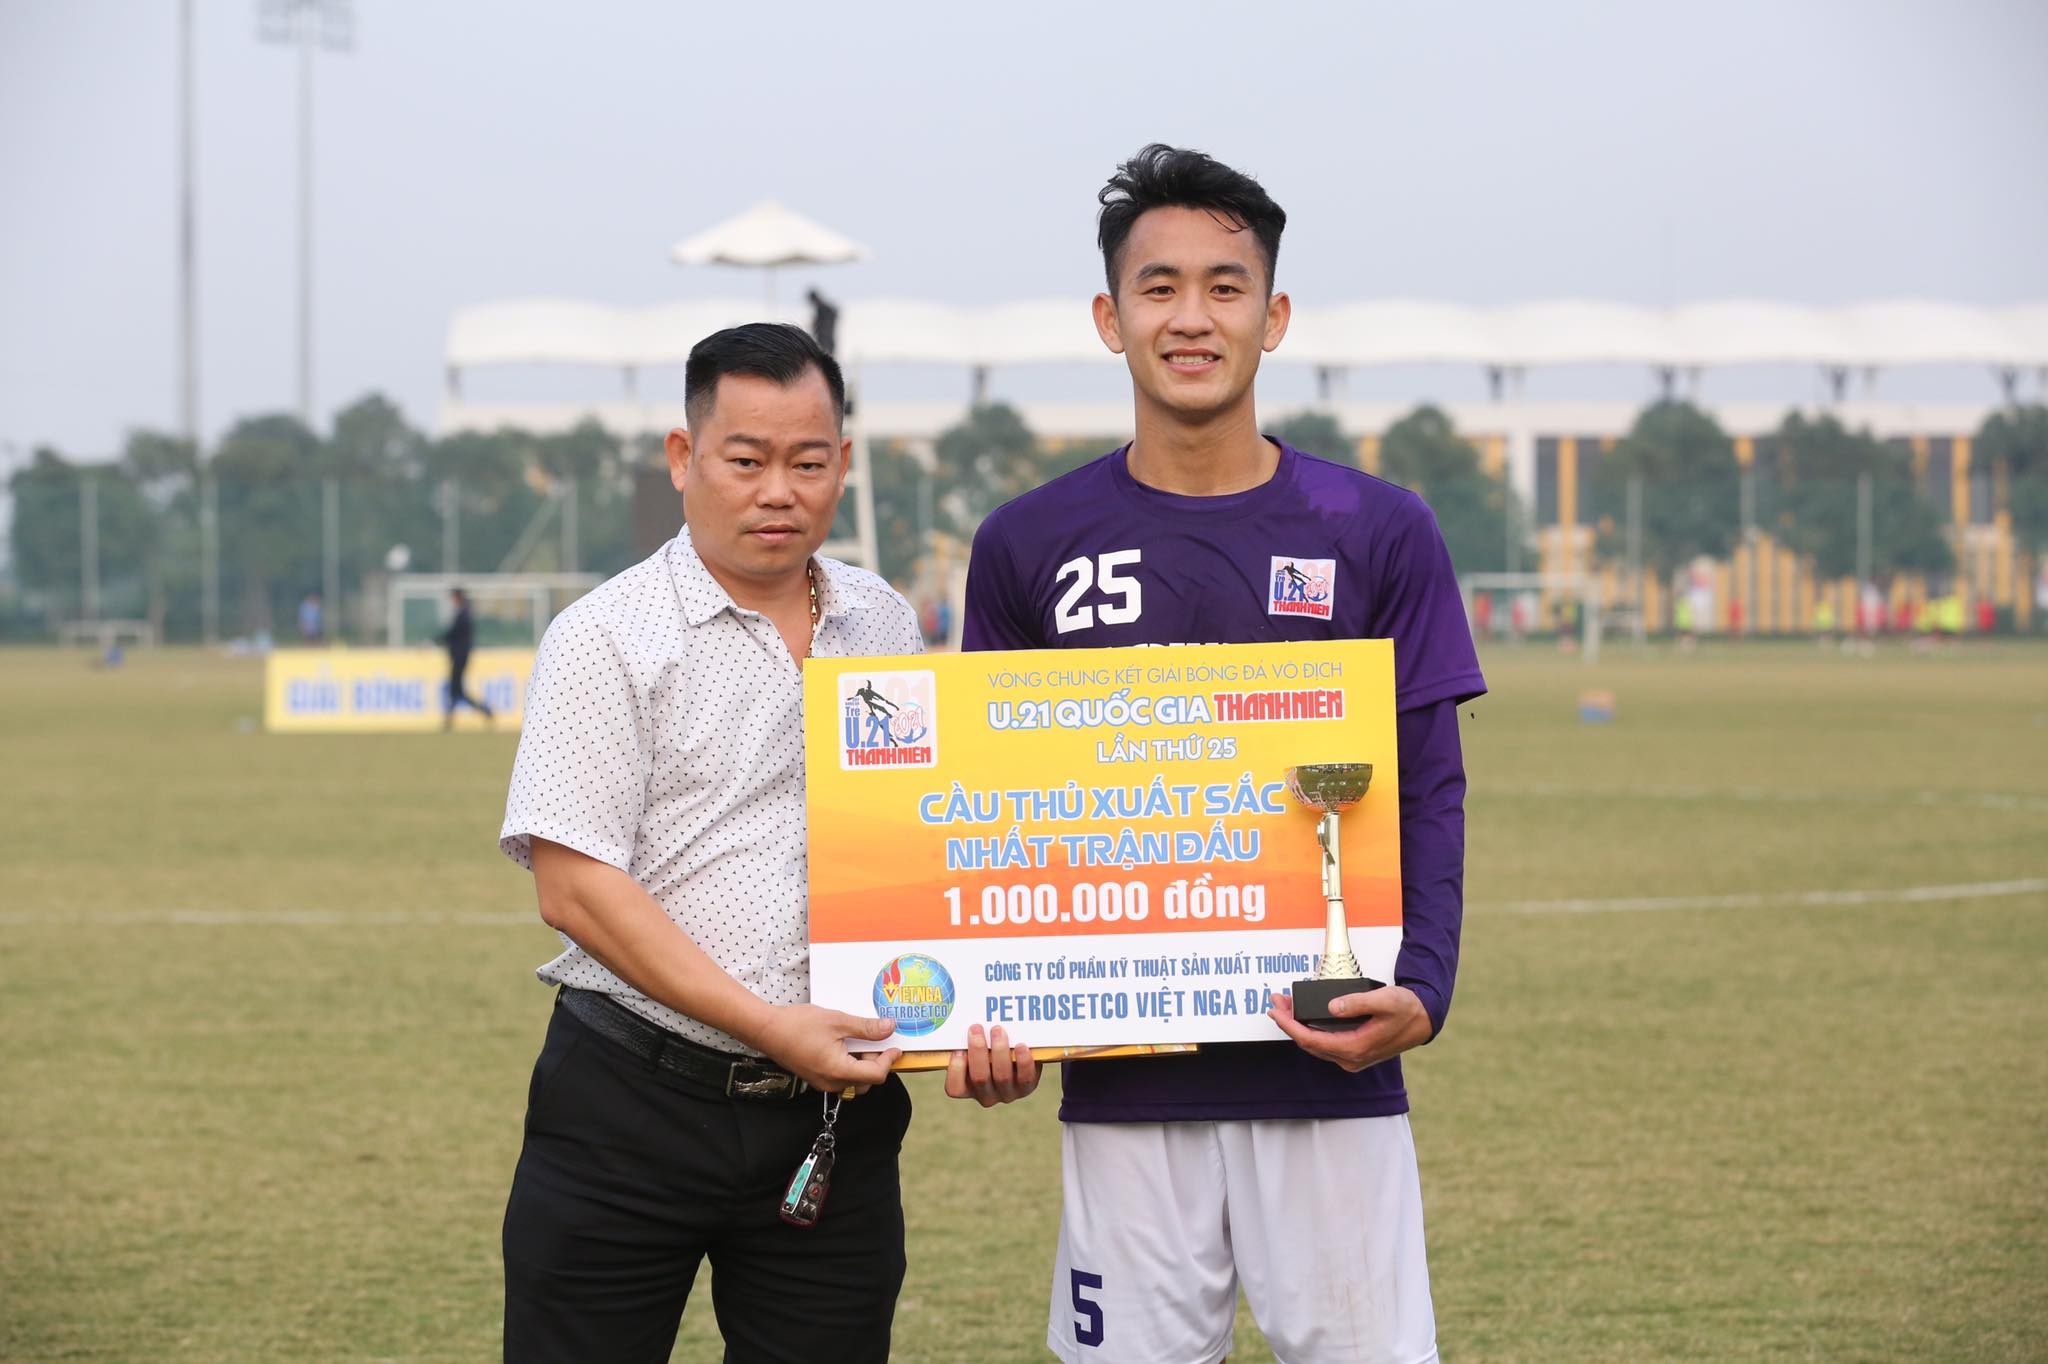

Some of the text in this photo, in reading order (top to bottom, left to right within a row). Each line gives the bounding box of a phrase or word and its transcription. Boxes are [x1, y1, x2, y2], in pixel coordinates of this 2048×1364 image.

[1055, 549, 1142, 635] 25
[1274, 580, 1305, 601] U.21
[988, 659, 1343, 688] VÒNG CHUNG KẾT GIẢI BÓNG ĐÁ VÔ ĐỊCH
[987, 699, 1051, 730] U.21
[1054, 687, 1152, 730] QUỐC
[1153, 694, 1212, 726] GIA
[845, 715, 890, 748] U.21
[1096, 731, 1237, 763] LẦN THỨ 25
[919, 771, 1286, 824] CẦU THỦ XUẤT SẮC
[946, 819, 1262, 871] NHẤT TRẬN ĐẤU
[943, 872, 1267, 926] 1.000.000 đồng
[985, 960, 1021, 982] CÔNG
[1025, 962, 1043, 981] TY
[1047, 955, 1067, 980] CỔ
[1069, 955, 1106, 979] PHẦN
[1109, 956, 1129, 978] KỸ
[1133, 955, 1178, 981] THUẬT
[1181, 951, 1210, 976] SẢN
[1214, 950, 1251, 975] XUẤT
[1255, 952, 1310, 974] THƯƠNG
[880, 1005, 948, 1018] PETROSETCO
[986, 991, 1129, 1022] PETROSETCO
[1136, 985, 1185, 1023] VIỆT
[1193, 989, 1238, 1017] NGA
[1244, 982, 1275, 1015] ĐÀ
[1070, 1267, 1104, 1348] 5
